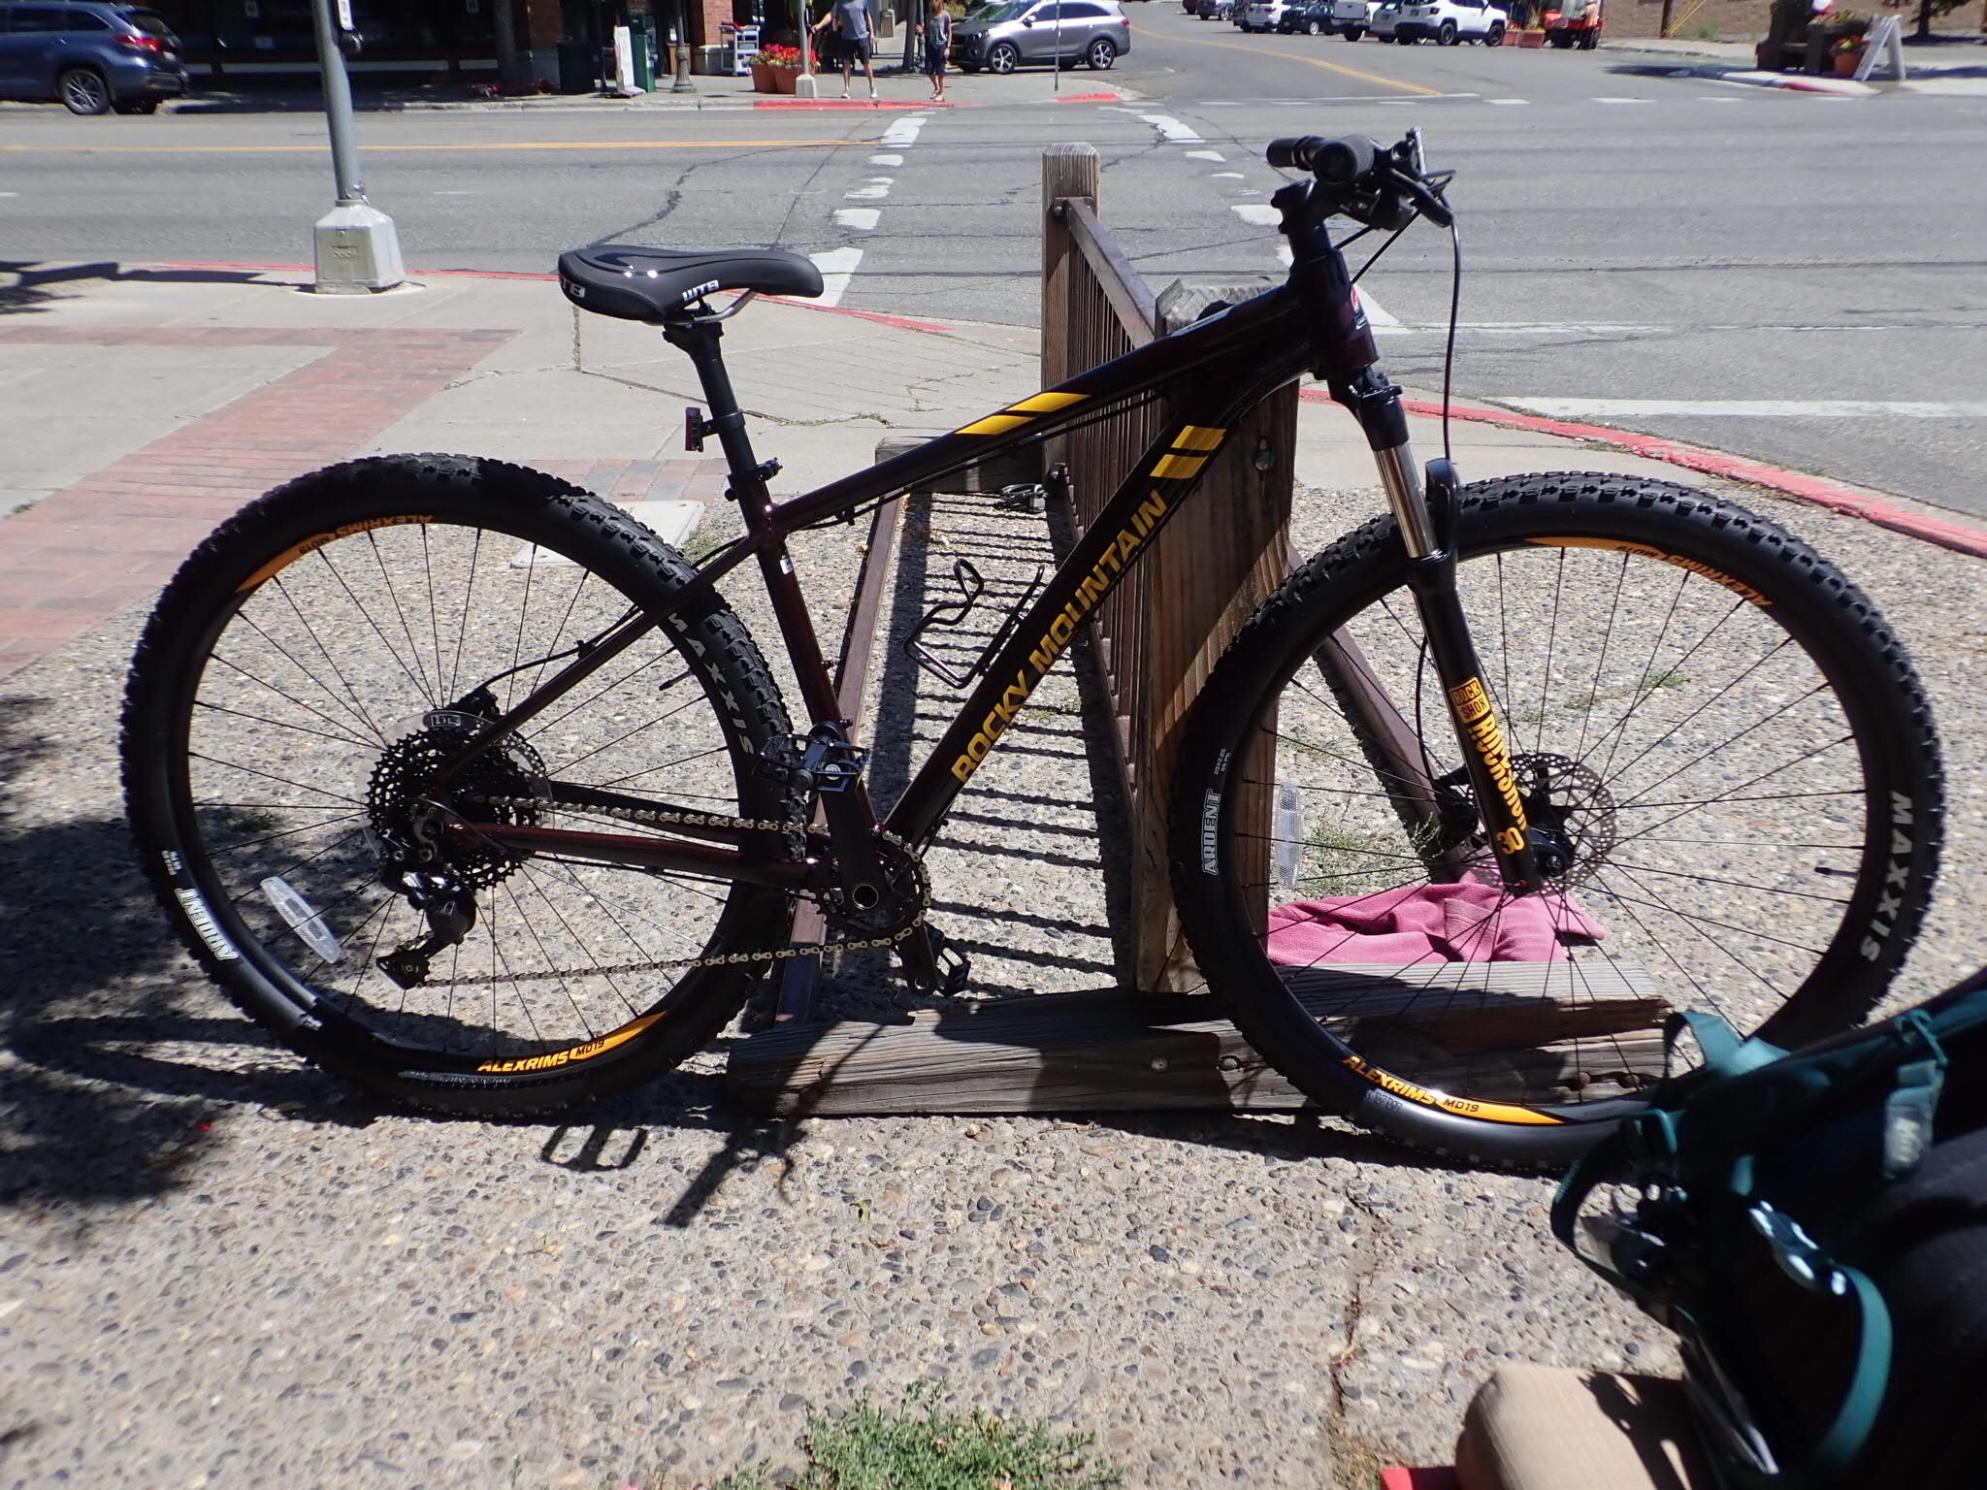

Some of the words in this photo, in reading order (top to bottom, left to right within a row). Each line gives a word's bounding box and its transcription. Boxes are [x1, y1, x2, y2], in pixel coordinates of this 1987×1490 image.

[560, 278, 586, 299] TB
[681, 279, 720, 302] WTB
[335, 514, 433, 539] ALEXRIMS
[1666, 555, 1774, 606] ALEXRIMS
[951, 669, 1032, 783] ROCKY
[1028, 488, 1169, 675] MOUNTAIN
[667, 612, 754, 755] MAXXIS
[1452, 679, 1482, 707] ROCK
[1200, 788, 1222, 876] ARDENT
[1497, 826, 1526, 855] 30
[1859, 790, 1914, 962] MAXXIS
[174, 887, 240, 961] ARDENT
[477, 1050, 570, 1073] ALEXRIMS
[1343, 1055, 1435, 1106] ALEXRIMS
[1443, 1098, 1480, 1113] MD19
